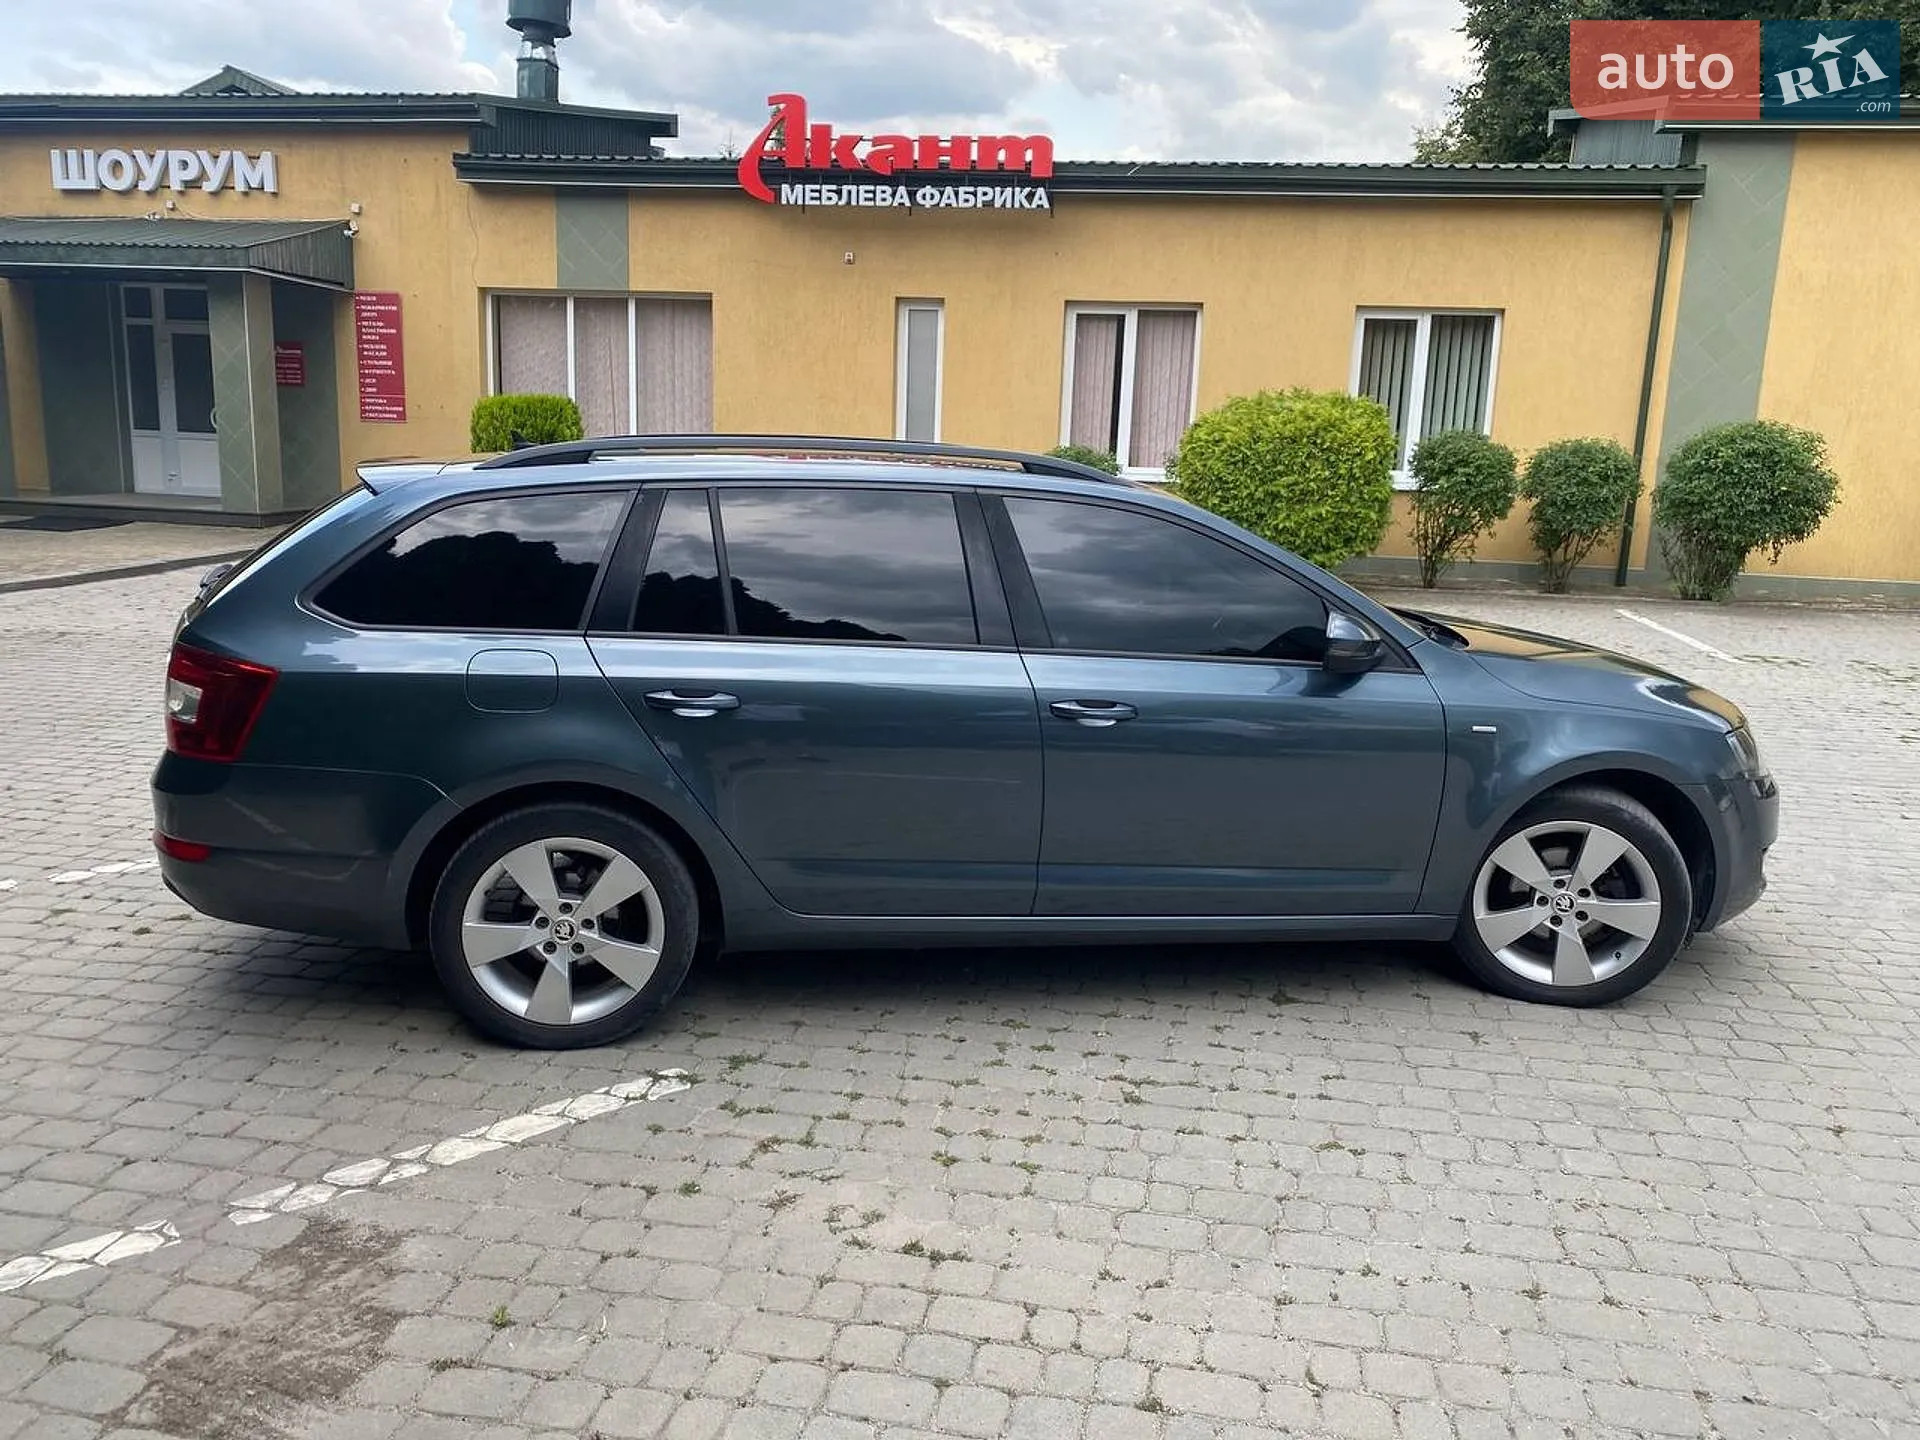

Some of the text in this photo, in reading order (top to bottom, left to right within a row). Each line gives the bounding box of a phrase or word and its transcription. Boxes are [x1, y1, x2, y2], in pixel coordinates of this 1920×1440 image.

[737, 92, 1055, 205] Акант
[50, 149, 279, 194] ШОУРУМ
[780, 183, 1050, 210] МЕБЛЕВА ФАБРИКА
